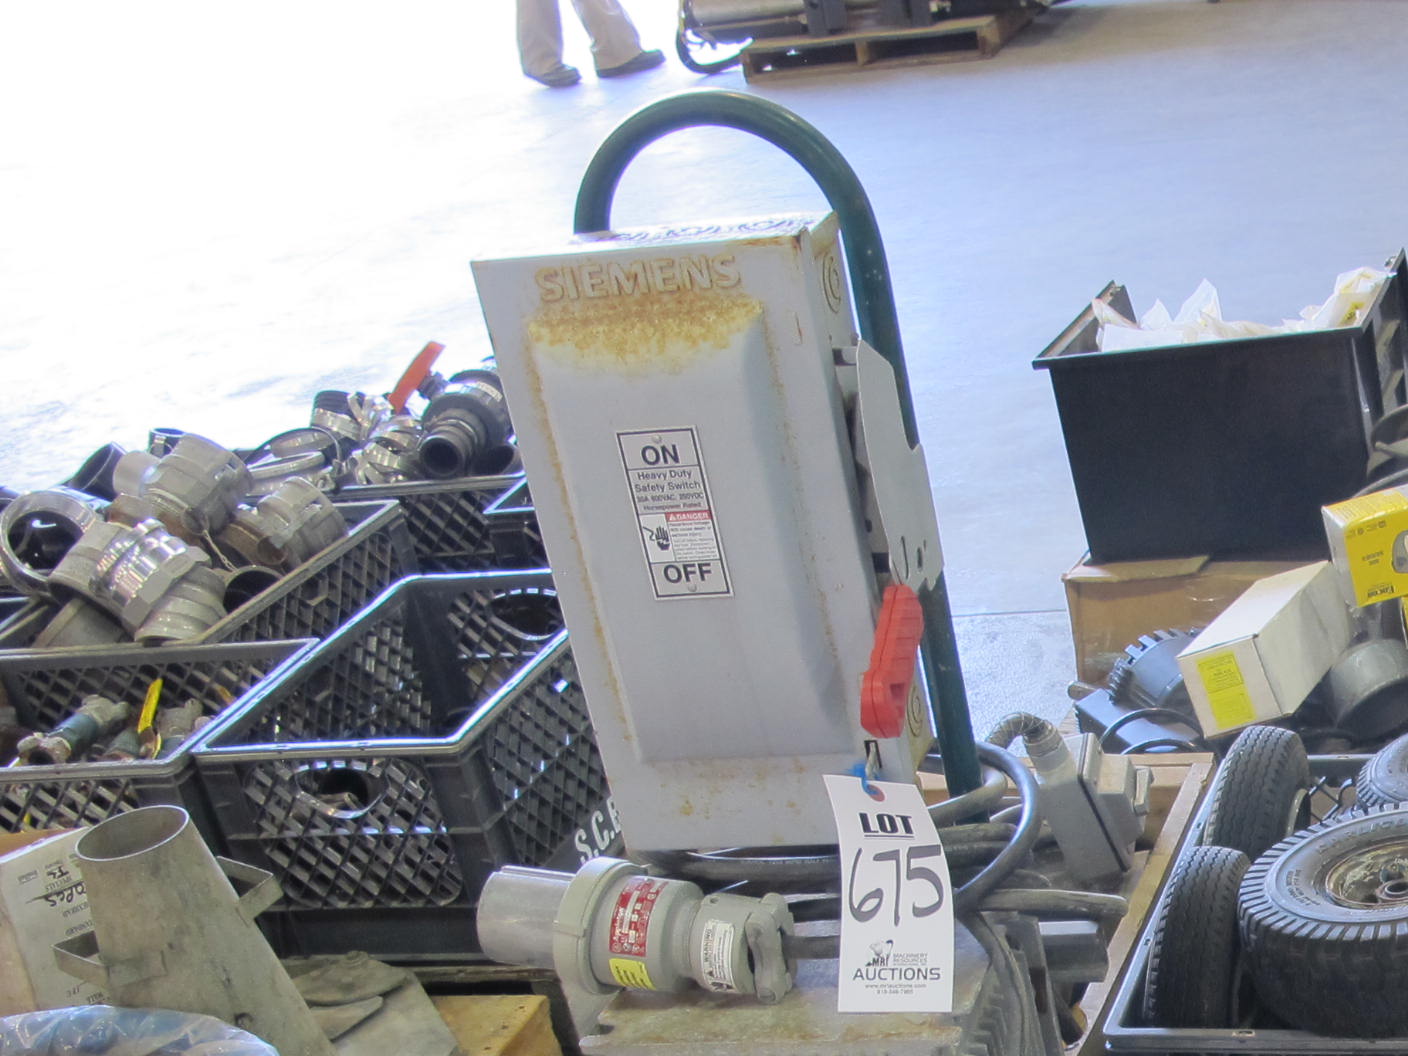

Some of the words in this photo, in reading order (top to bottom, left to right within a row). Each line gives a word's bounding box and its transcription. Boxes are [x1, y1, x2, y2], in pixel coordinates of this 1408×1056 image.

[535, 254, 741, 302] SIEMENS
[641, 444, 680, 466] ON
[637, 471, 668, 481] Heavy
[669, 469, 692, 479] Duty
[635, 482, 665, 493] Safety
[668, 480, 700, 491] Switch
[676, 512, 708, 520] DANGER
[664, 562, 711, 584] OFF
[859, 812, 913, 835] LOT
[848, 844, 944, 927] 675
[853, 968, 941, 980] AUCTIONS
